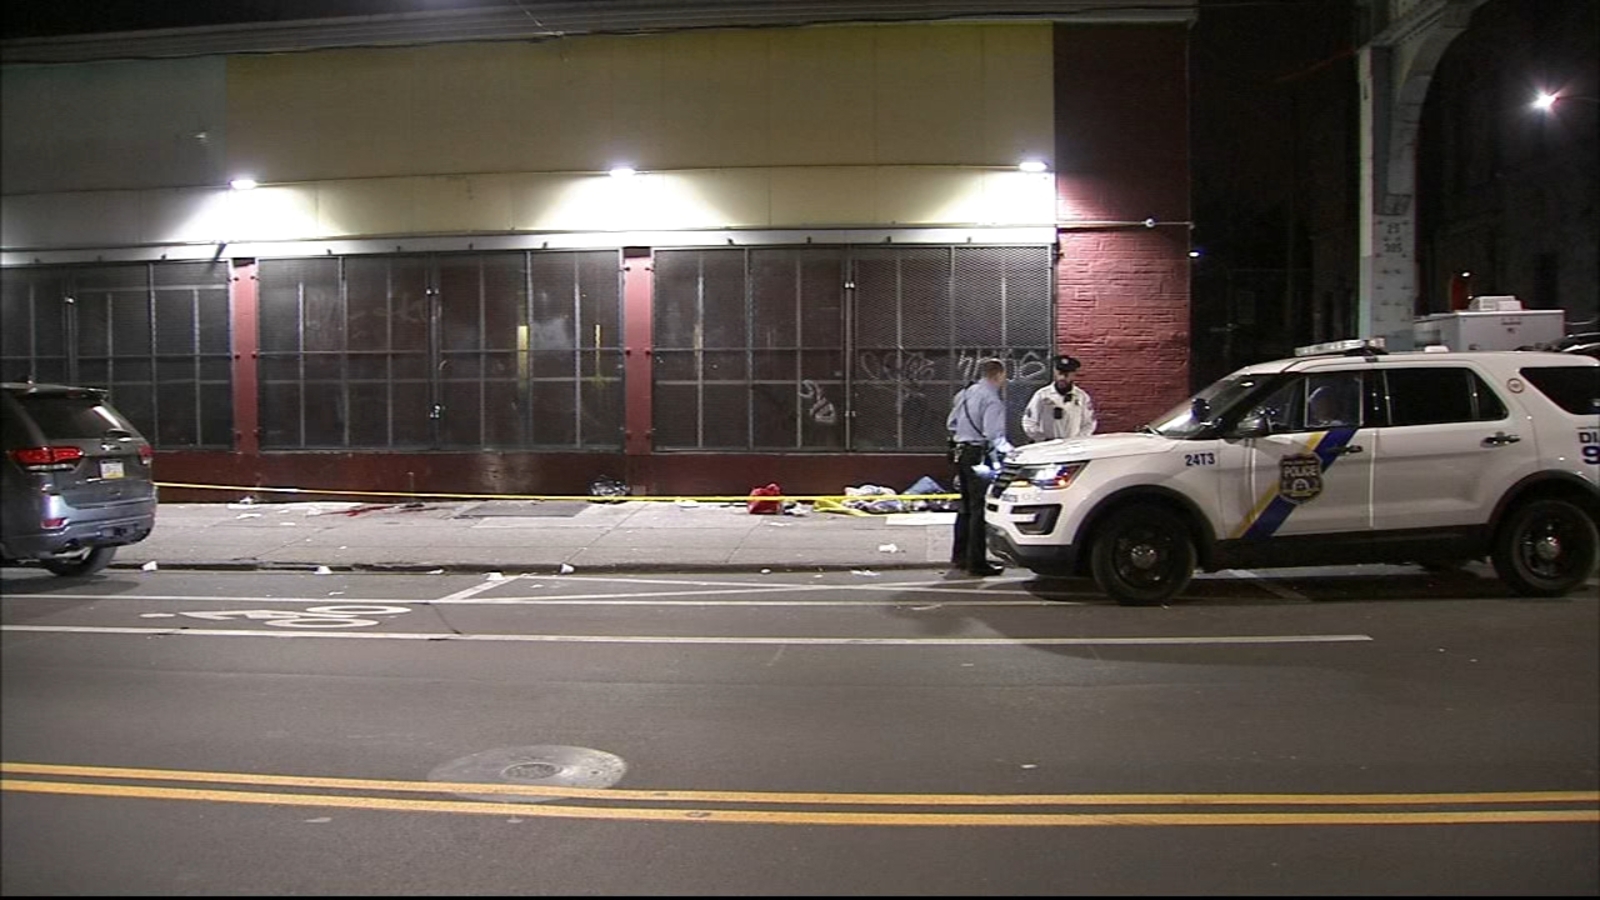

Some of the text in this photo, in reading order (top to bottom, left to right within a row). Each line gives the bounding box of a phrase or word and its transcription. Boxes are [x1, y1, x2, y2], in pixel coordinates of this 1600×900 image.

[1578, 431, 1600, 444] DI
[1184, 452, 1216, 467] 24T3
[1284, 465, 1318, 478] POLICE
